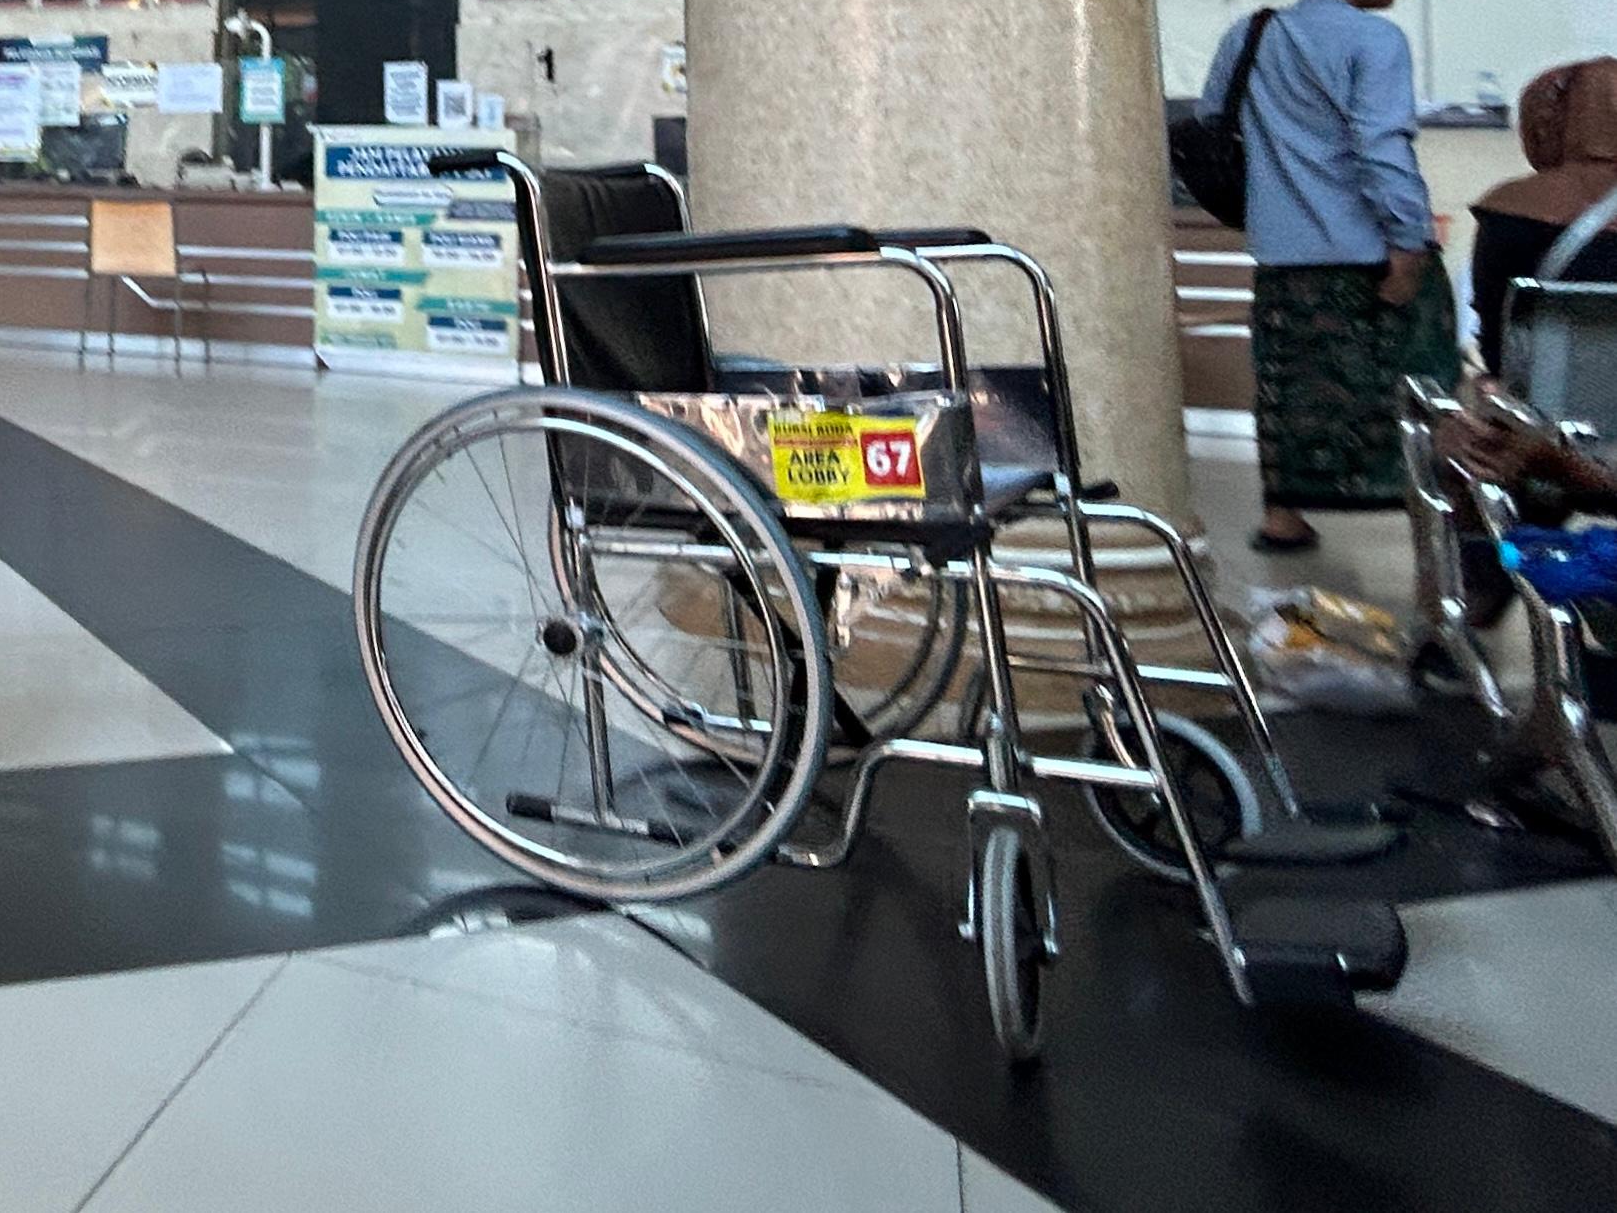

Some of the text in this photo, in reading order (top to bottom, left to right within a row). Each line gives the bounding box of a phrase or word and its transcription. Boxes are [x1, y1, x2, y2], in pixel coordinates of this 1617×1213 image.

[789, 447, 841, 467] AREA
[866, 439, 912, 478] 67
[788, 467, 850, 485] LOBBY
